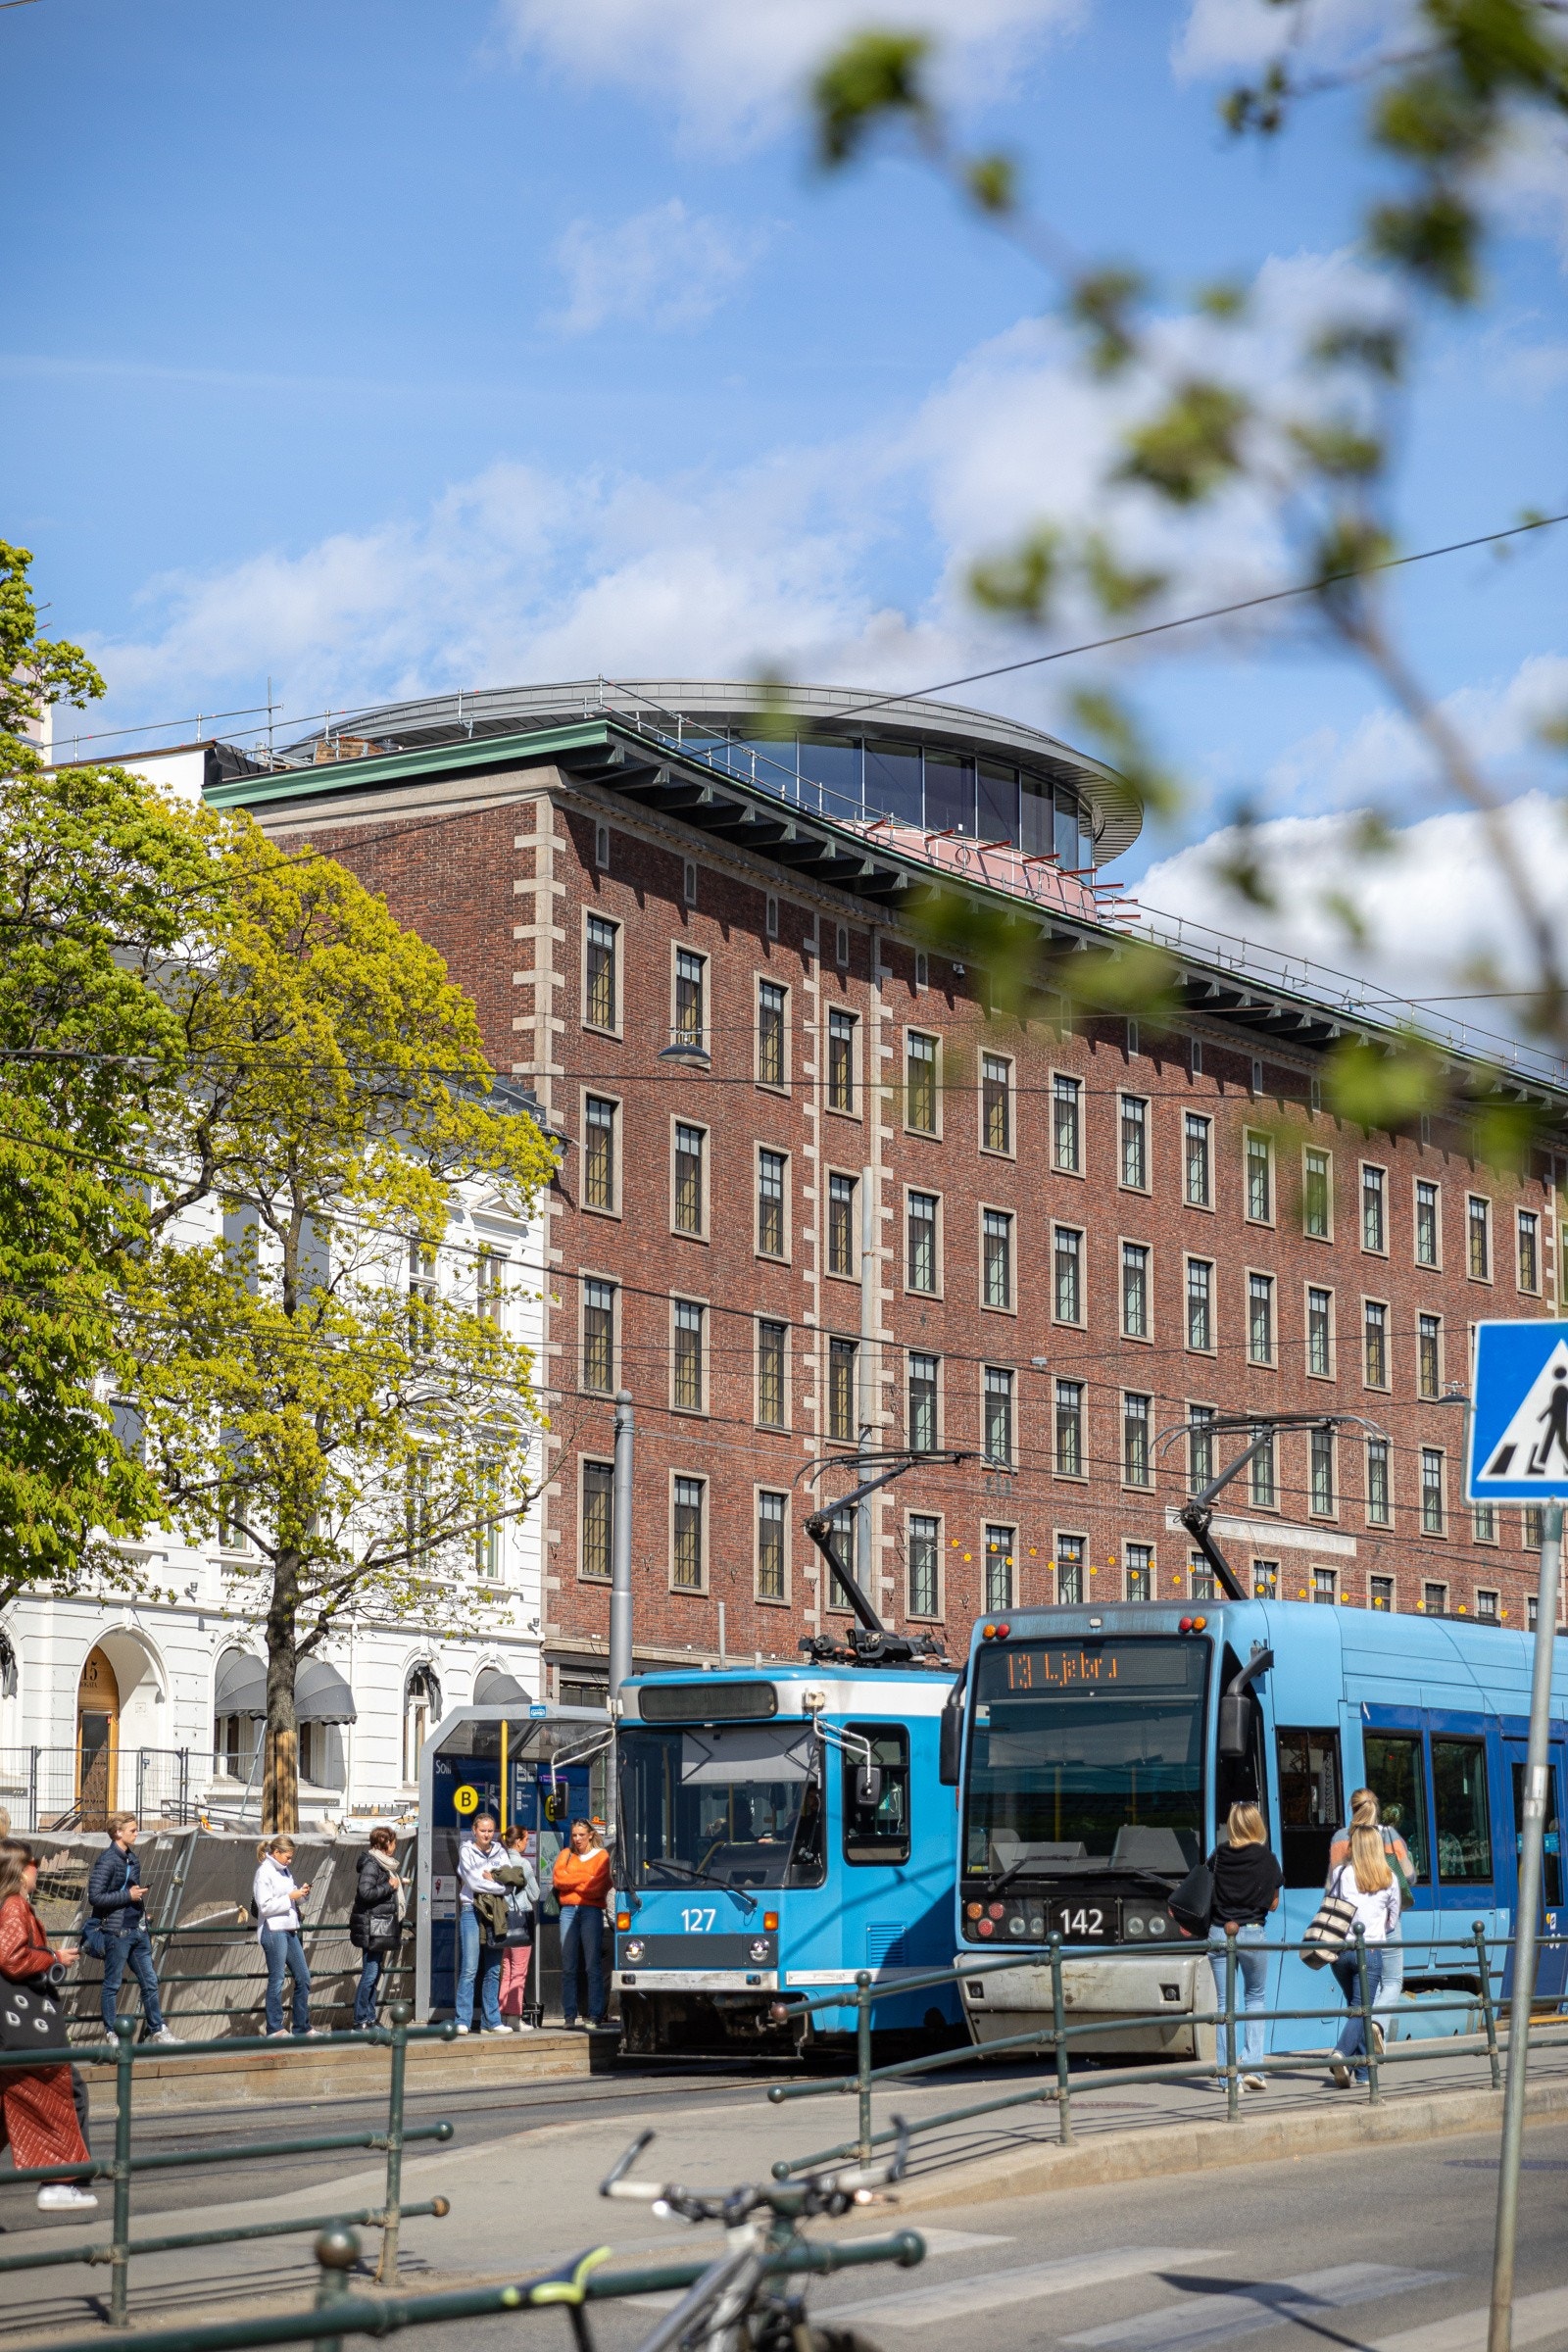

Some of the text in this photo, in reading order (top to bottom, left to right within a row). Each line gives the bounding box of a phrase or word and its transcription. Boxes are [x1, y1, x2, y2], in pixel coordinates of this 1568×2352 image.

[83, 1661, 98, 1682] 15
[1008, 1653, 1032, 1690] 13
[435, 1759, 452, 1775] Solli
[461, 1791, 472, 1808] B
[681, 1908, 716, 1932] 127
[1059, 1908, 1104, 1936] 142
